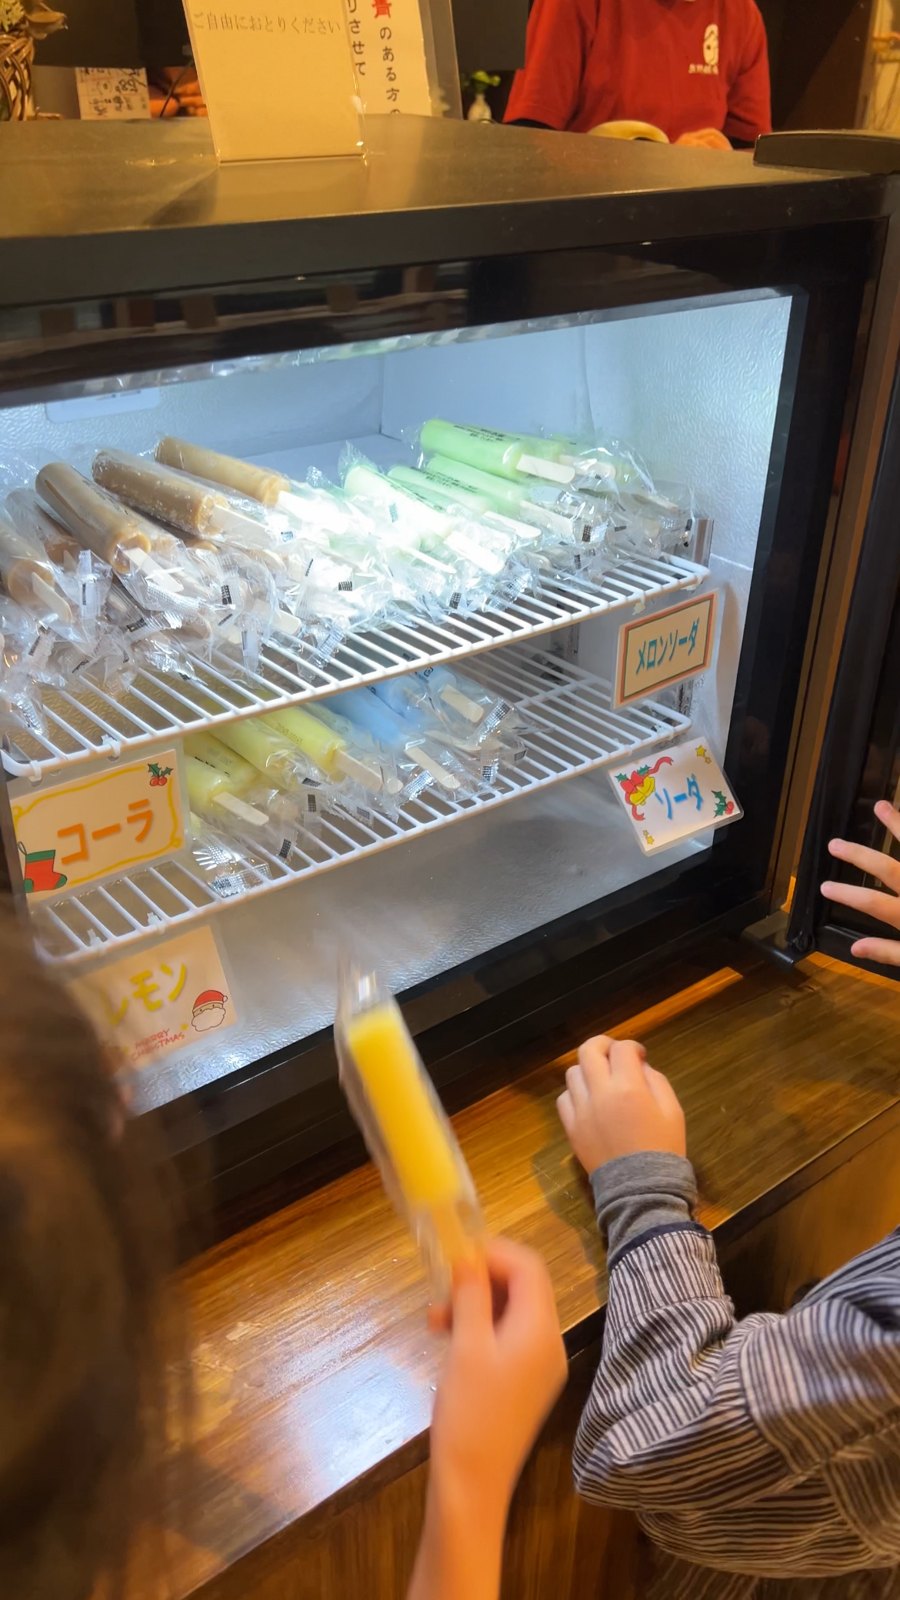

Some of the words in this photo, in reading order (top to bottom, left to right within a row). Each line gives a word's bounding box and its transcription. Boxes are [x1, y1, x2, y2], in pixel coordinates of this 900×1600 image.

[193, 10, 341, 35] ご自由におとりください
[372, 0, 400, 114] のある方
[635, 616, 700, 676] メロンソーダ
[655, 773, 704, 820] ソーダ
[57, 798, 154, 866] コーラ
[98, 963, 188, 1026] レモン
